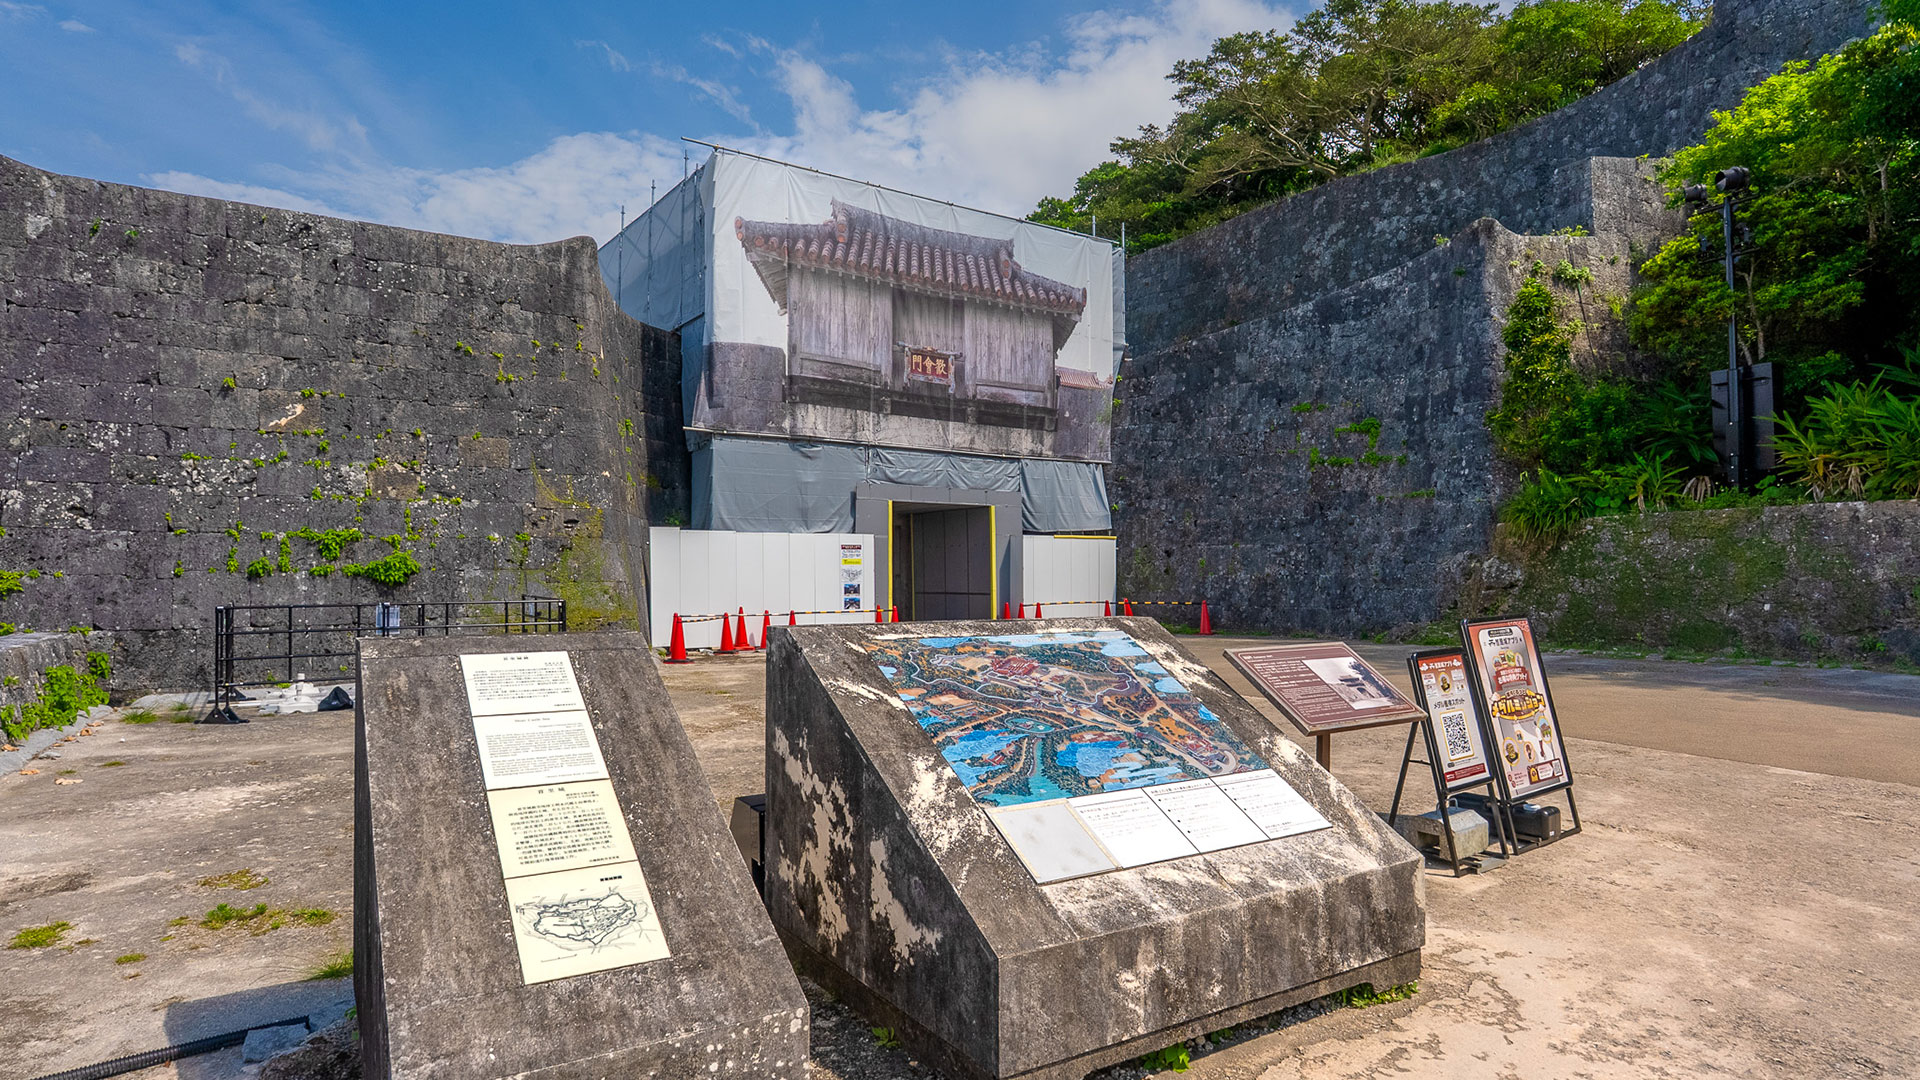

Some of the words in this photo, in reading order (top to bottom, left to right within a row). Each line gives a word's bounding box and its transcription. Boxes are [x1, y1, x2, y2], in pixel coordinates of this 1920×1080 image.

[1492, 694, 1546, 718] メダルミッション
